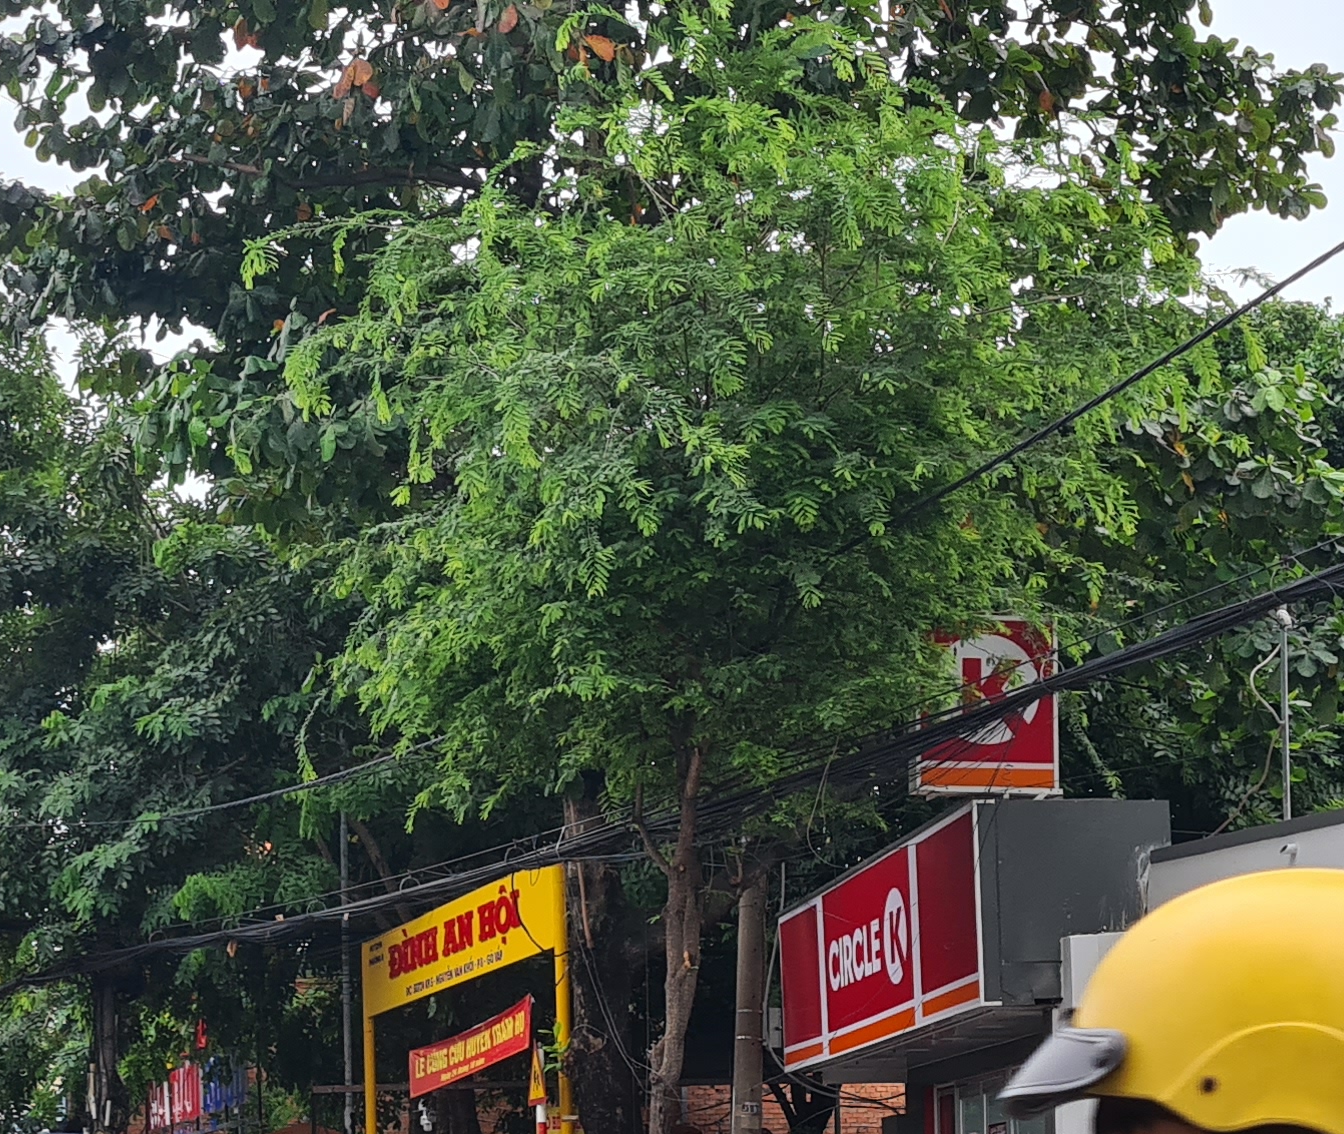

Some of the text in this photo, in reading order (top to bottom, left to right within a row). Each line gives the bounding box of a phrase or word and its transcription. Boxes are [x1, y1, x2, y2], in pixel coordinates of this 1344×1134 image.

[388, 929, 438, 980] ĐÌNH
[442, 910, 474, 957] AN
[828, 918, 882, 992] CIRCLE
